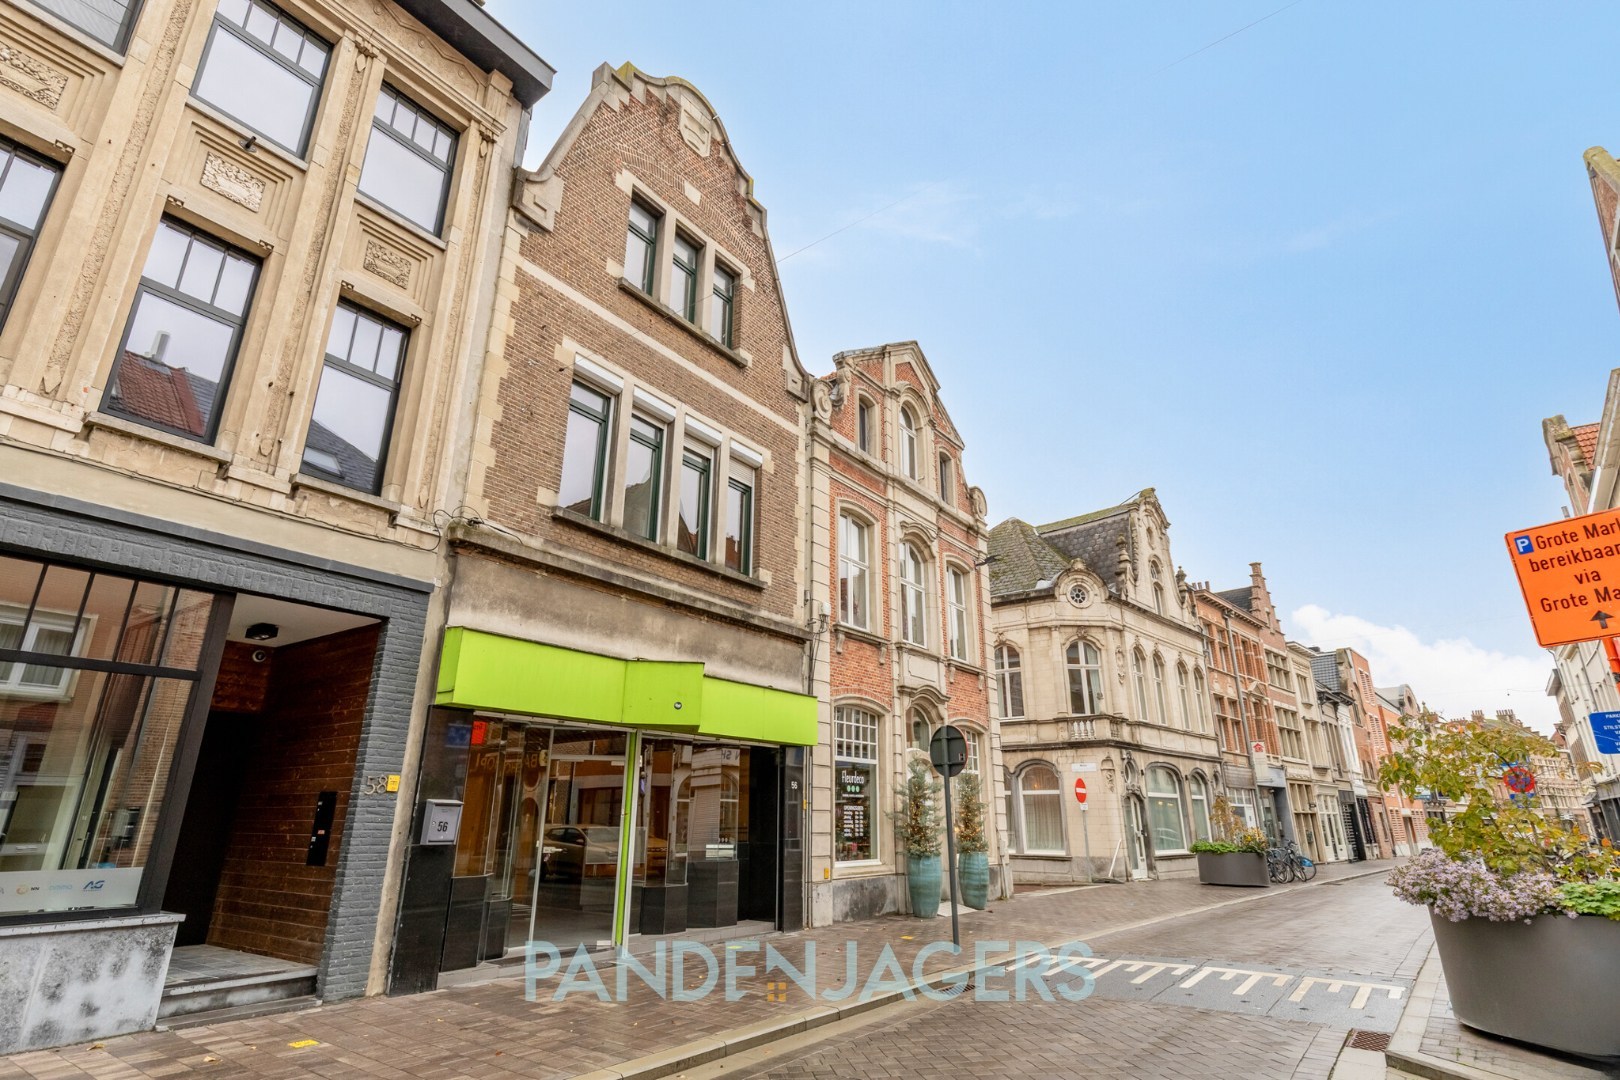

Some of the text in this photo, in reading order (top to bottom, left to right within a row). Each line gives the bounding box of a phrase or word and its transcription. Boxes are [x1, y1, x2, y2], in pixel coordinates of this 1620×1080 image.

[1535, 531, 1579, 550] Grote
[1574, 569, 1601, 585] via
[1540, 593, 1588, 613] Grote
[364, 774, 388, 795] 58
[841, 770, 865, 784] Fleurdeco
[790, 781, 798, 789] 56
[437, 821, 448, 832] 56
[83, 880, 105, 890] AG
